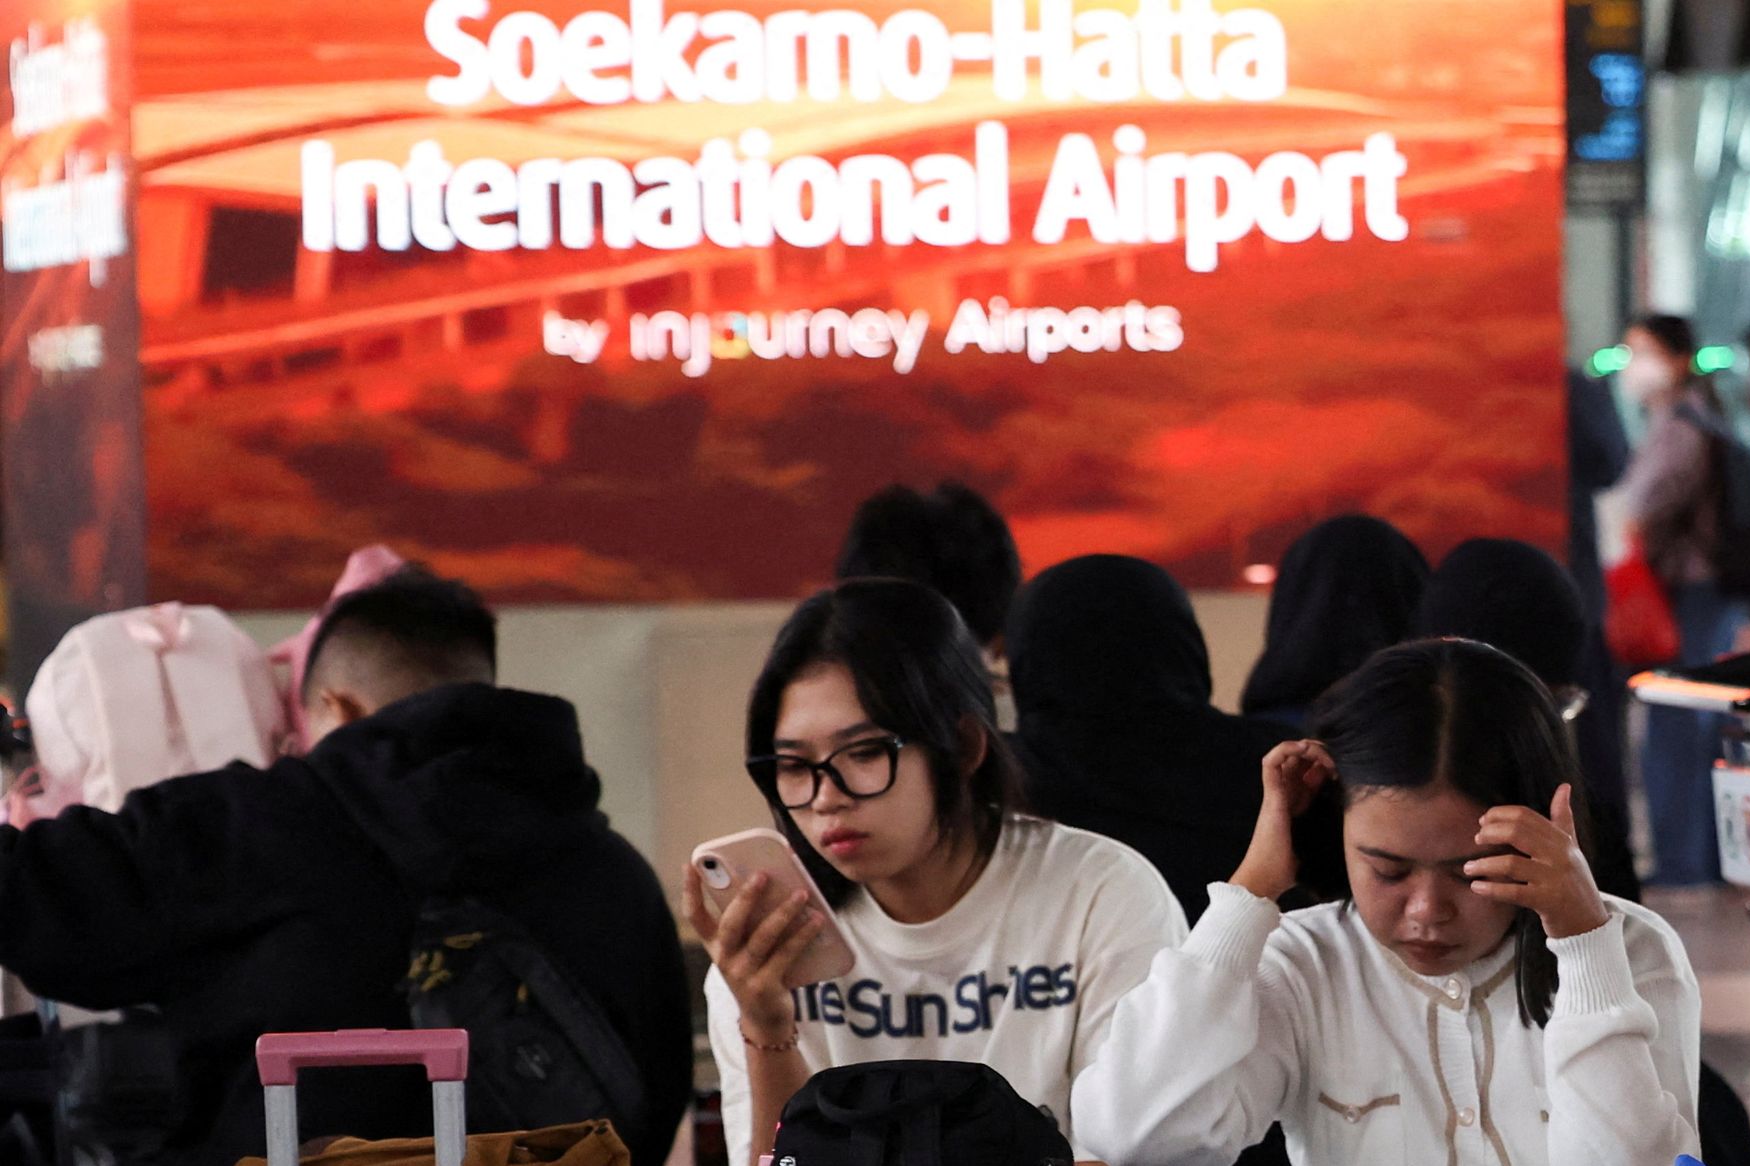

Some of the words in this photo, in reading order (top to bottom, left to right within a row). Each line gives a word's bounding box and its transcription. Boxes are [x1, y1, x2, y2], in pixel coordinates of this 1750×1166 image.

[425, 0, 1287, 103] Soekarno-Hatta
[300, 121, 1010, 250] International
[1034, 125, 1408, 272] Airport
[543, 311, 609, 363] by
[944, 297, 1184, 363] Airports
